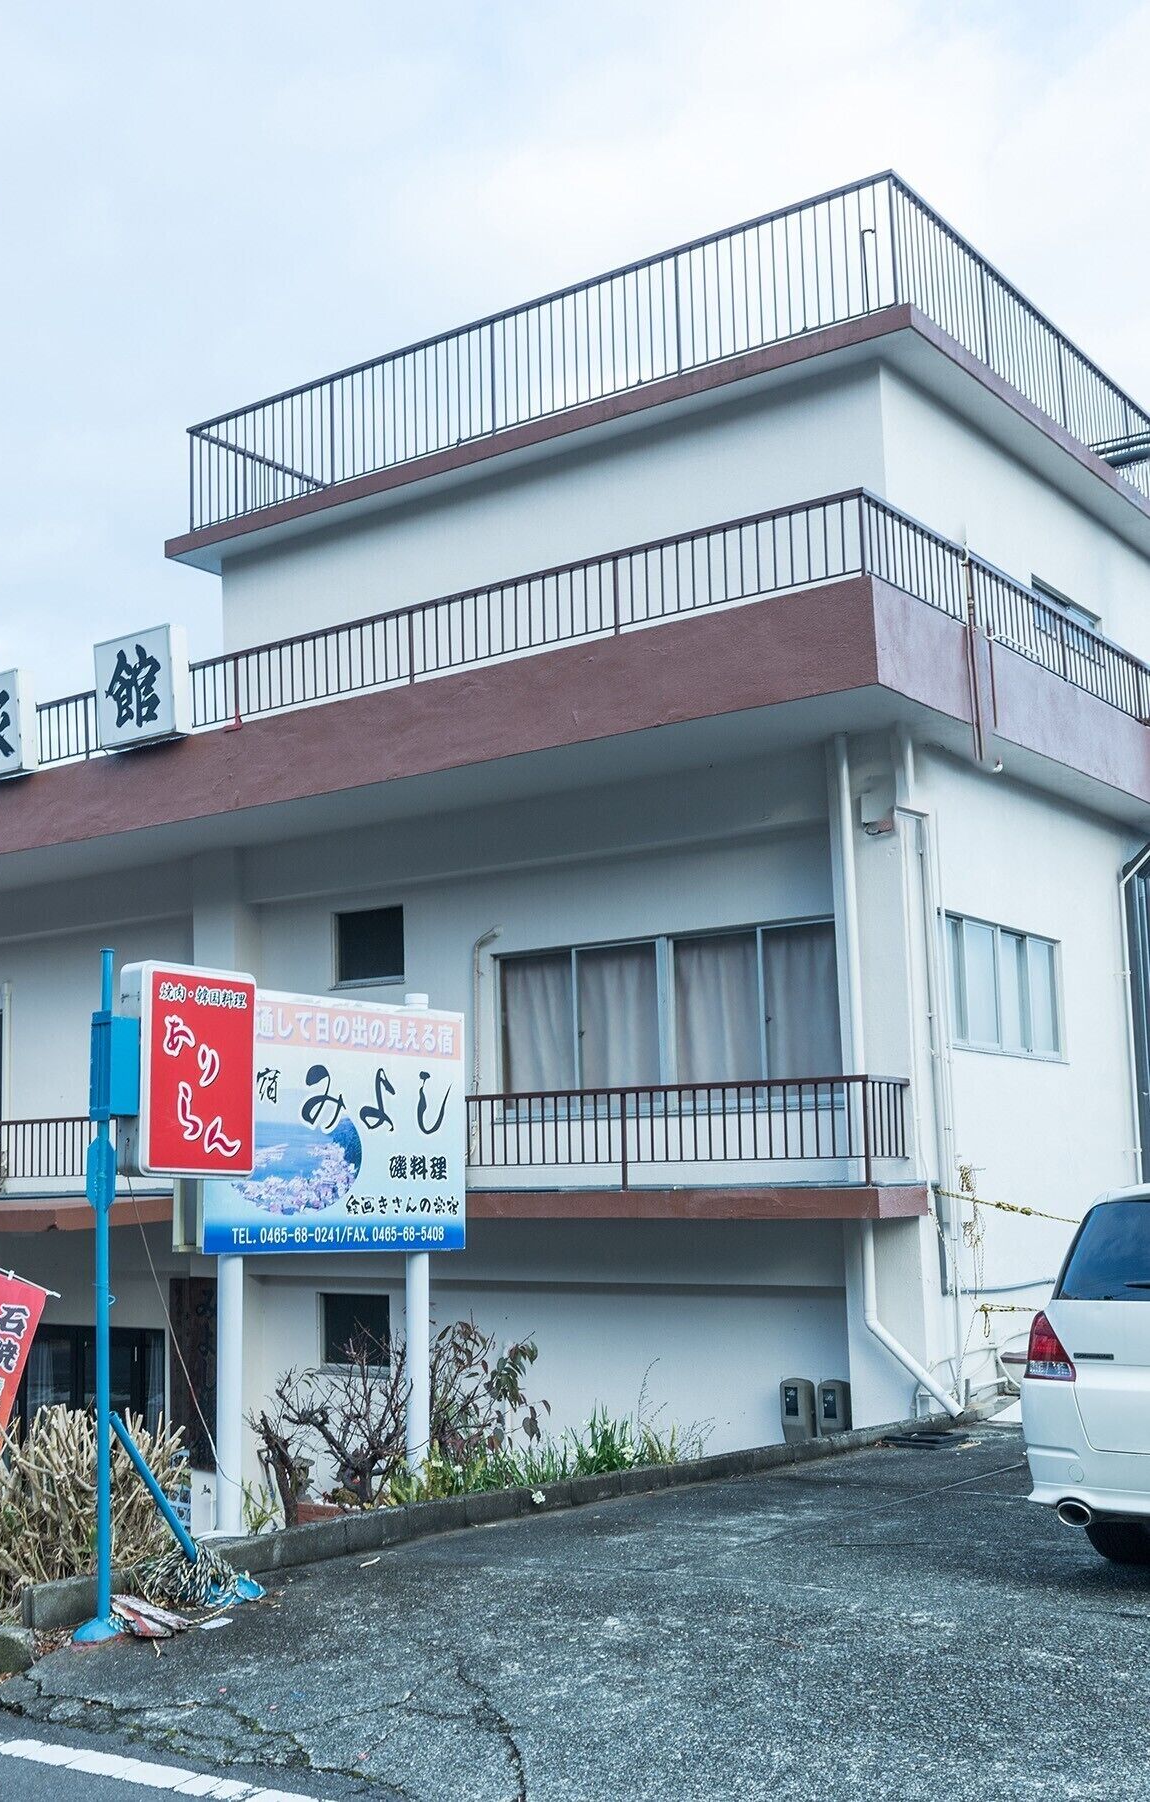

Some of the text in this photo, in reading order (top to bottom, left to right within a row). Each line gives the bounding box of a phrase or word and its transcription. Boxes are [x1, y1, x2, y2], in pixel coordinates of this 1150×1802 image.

[159, 982, 247, 1008] 焼肉・韓国料理
[255, 1005, 454, 1057] 通して日の出の見える宿
[301, 1064, 453, 1135] みよし
[389, 1155, 448, 1181] 磯料理
[232, 1227, 257, 1244] TEL.
[372, 1225, 444, 1243] 0465-68-5408
